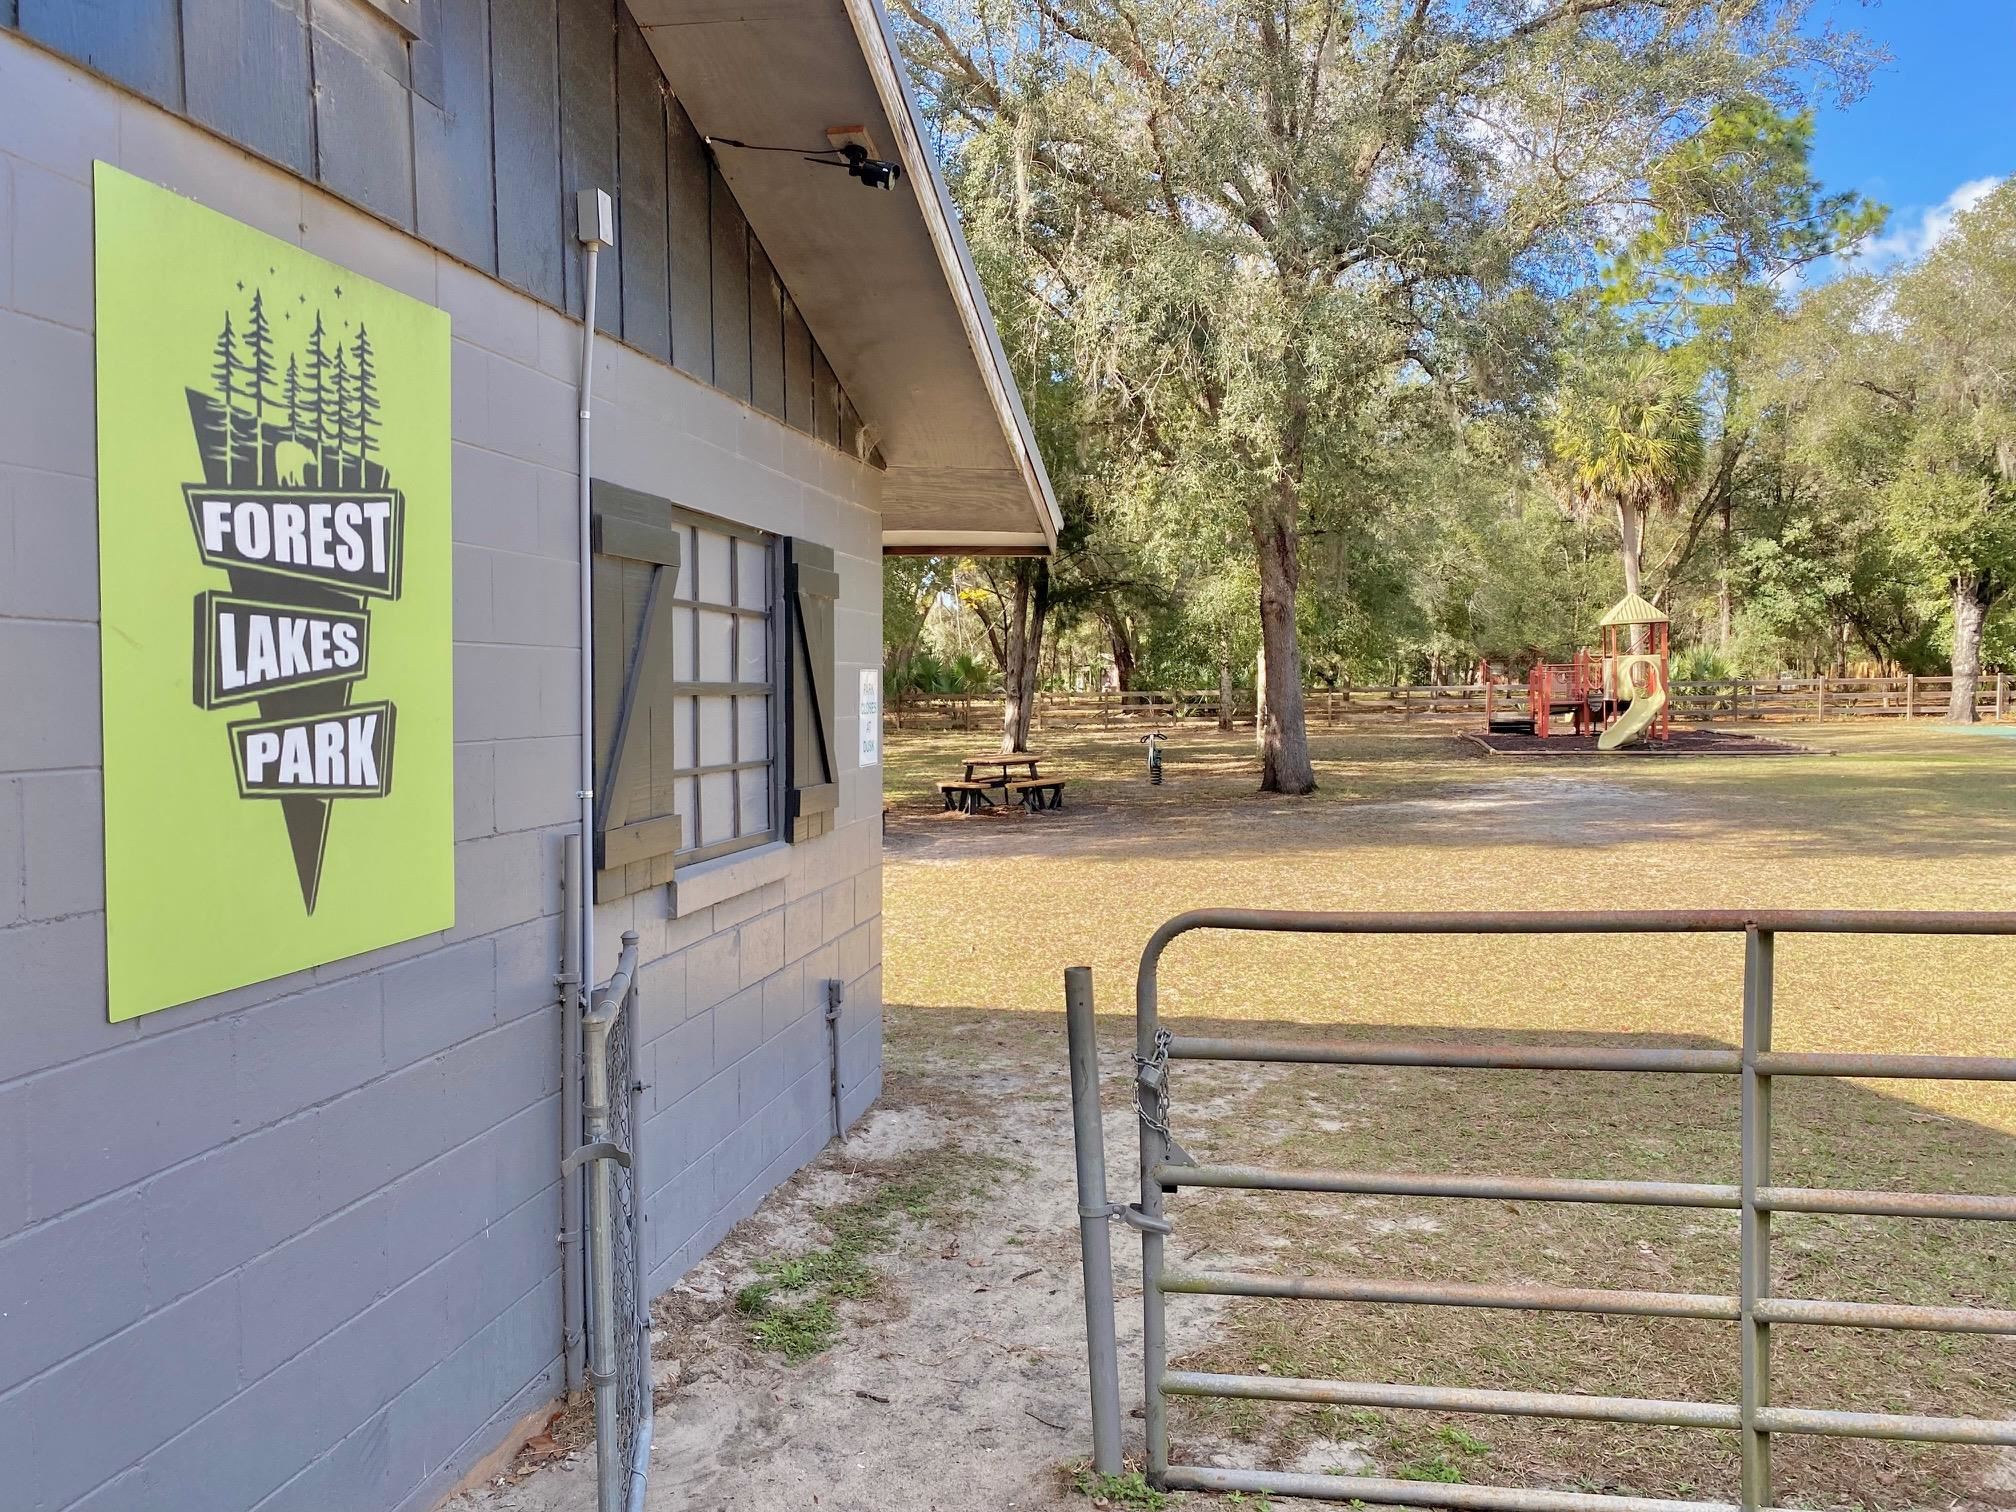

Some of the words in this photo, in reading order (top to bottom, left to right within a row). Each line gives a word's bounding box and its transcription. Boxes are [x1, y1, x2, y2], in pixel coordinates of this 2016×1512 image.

[202, 500, 390, 573] FOREST
[219, 612, 359, 690] LAKES
[246, 714, 379, 785] PARK
[863, 740, 875, 752] DUSK
